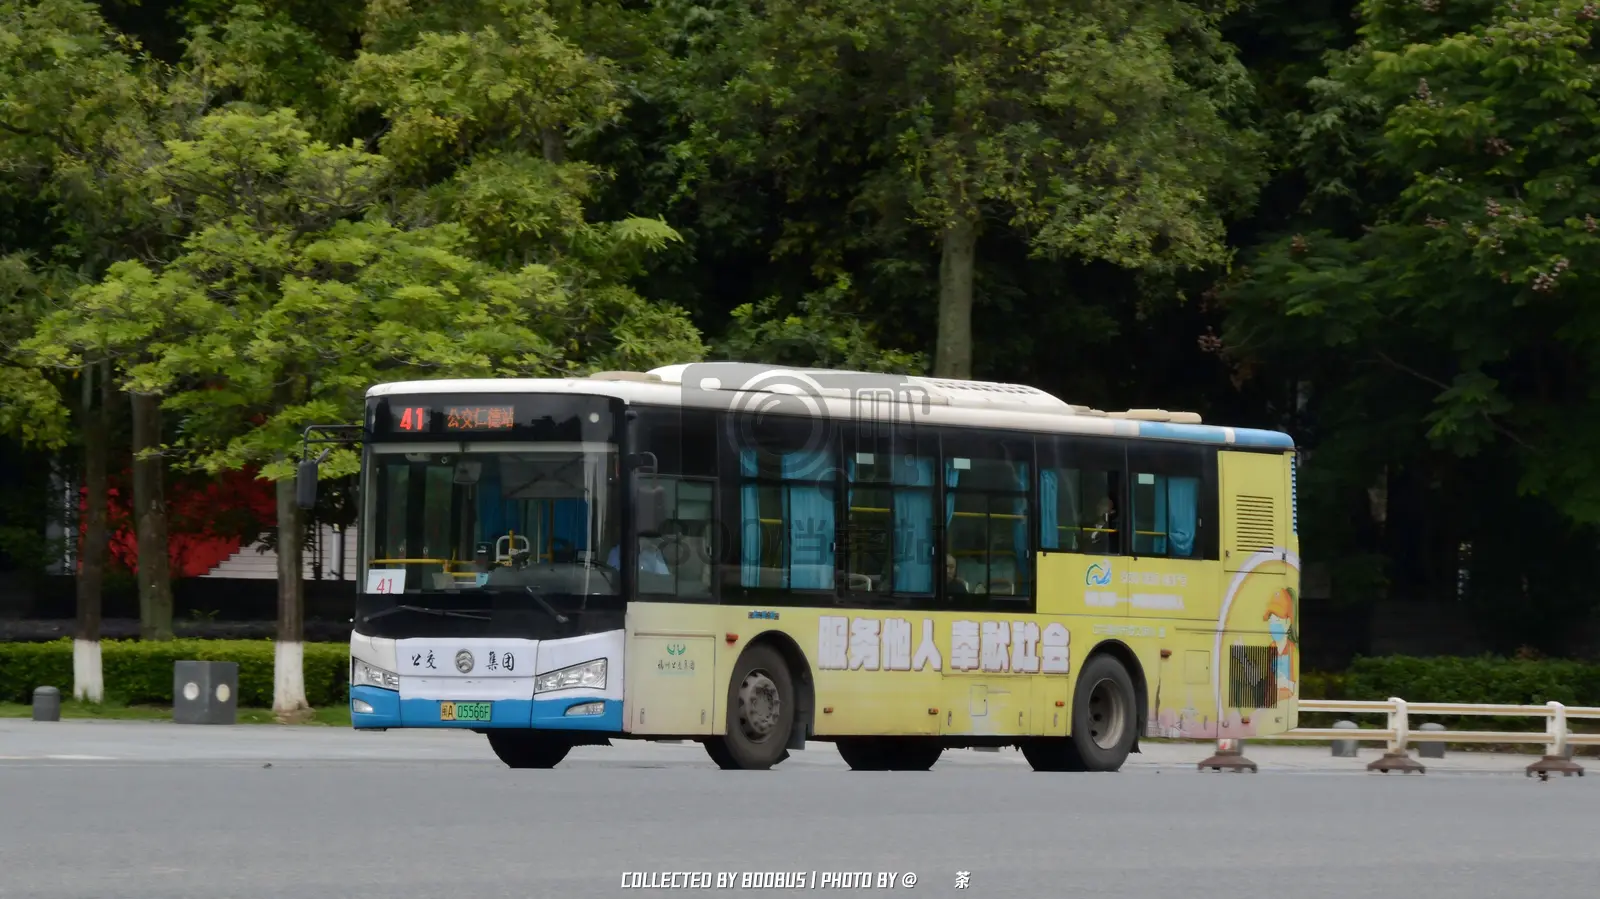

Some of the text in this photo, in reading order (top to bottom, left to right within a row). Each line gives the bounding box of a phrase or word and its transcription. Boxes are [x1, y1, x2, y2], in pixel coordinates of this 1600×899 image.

[400, 407, 424, 431] 41
[376, 578, 393, 595] 41
[818, 615, 1071, 675] 服务他人 奉献社会
[411, 649, 515, 672] 公交 集团
